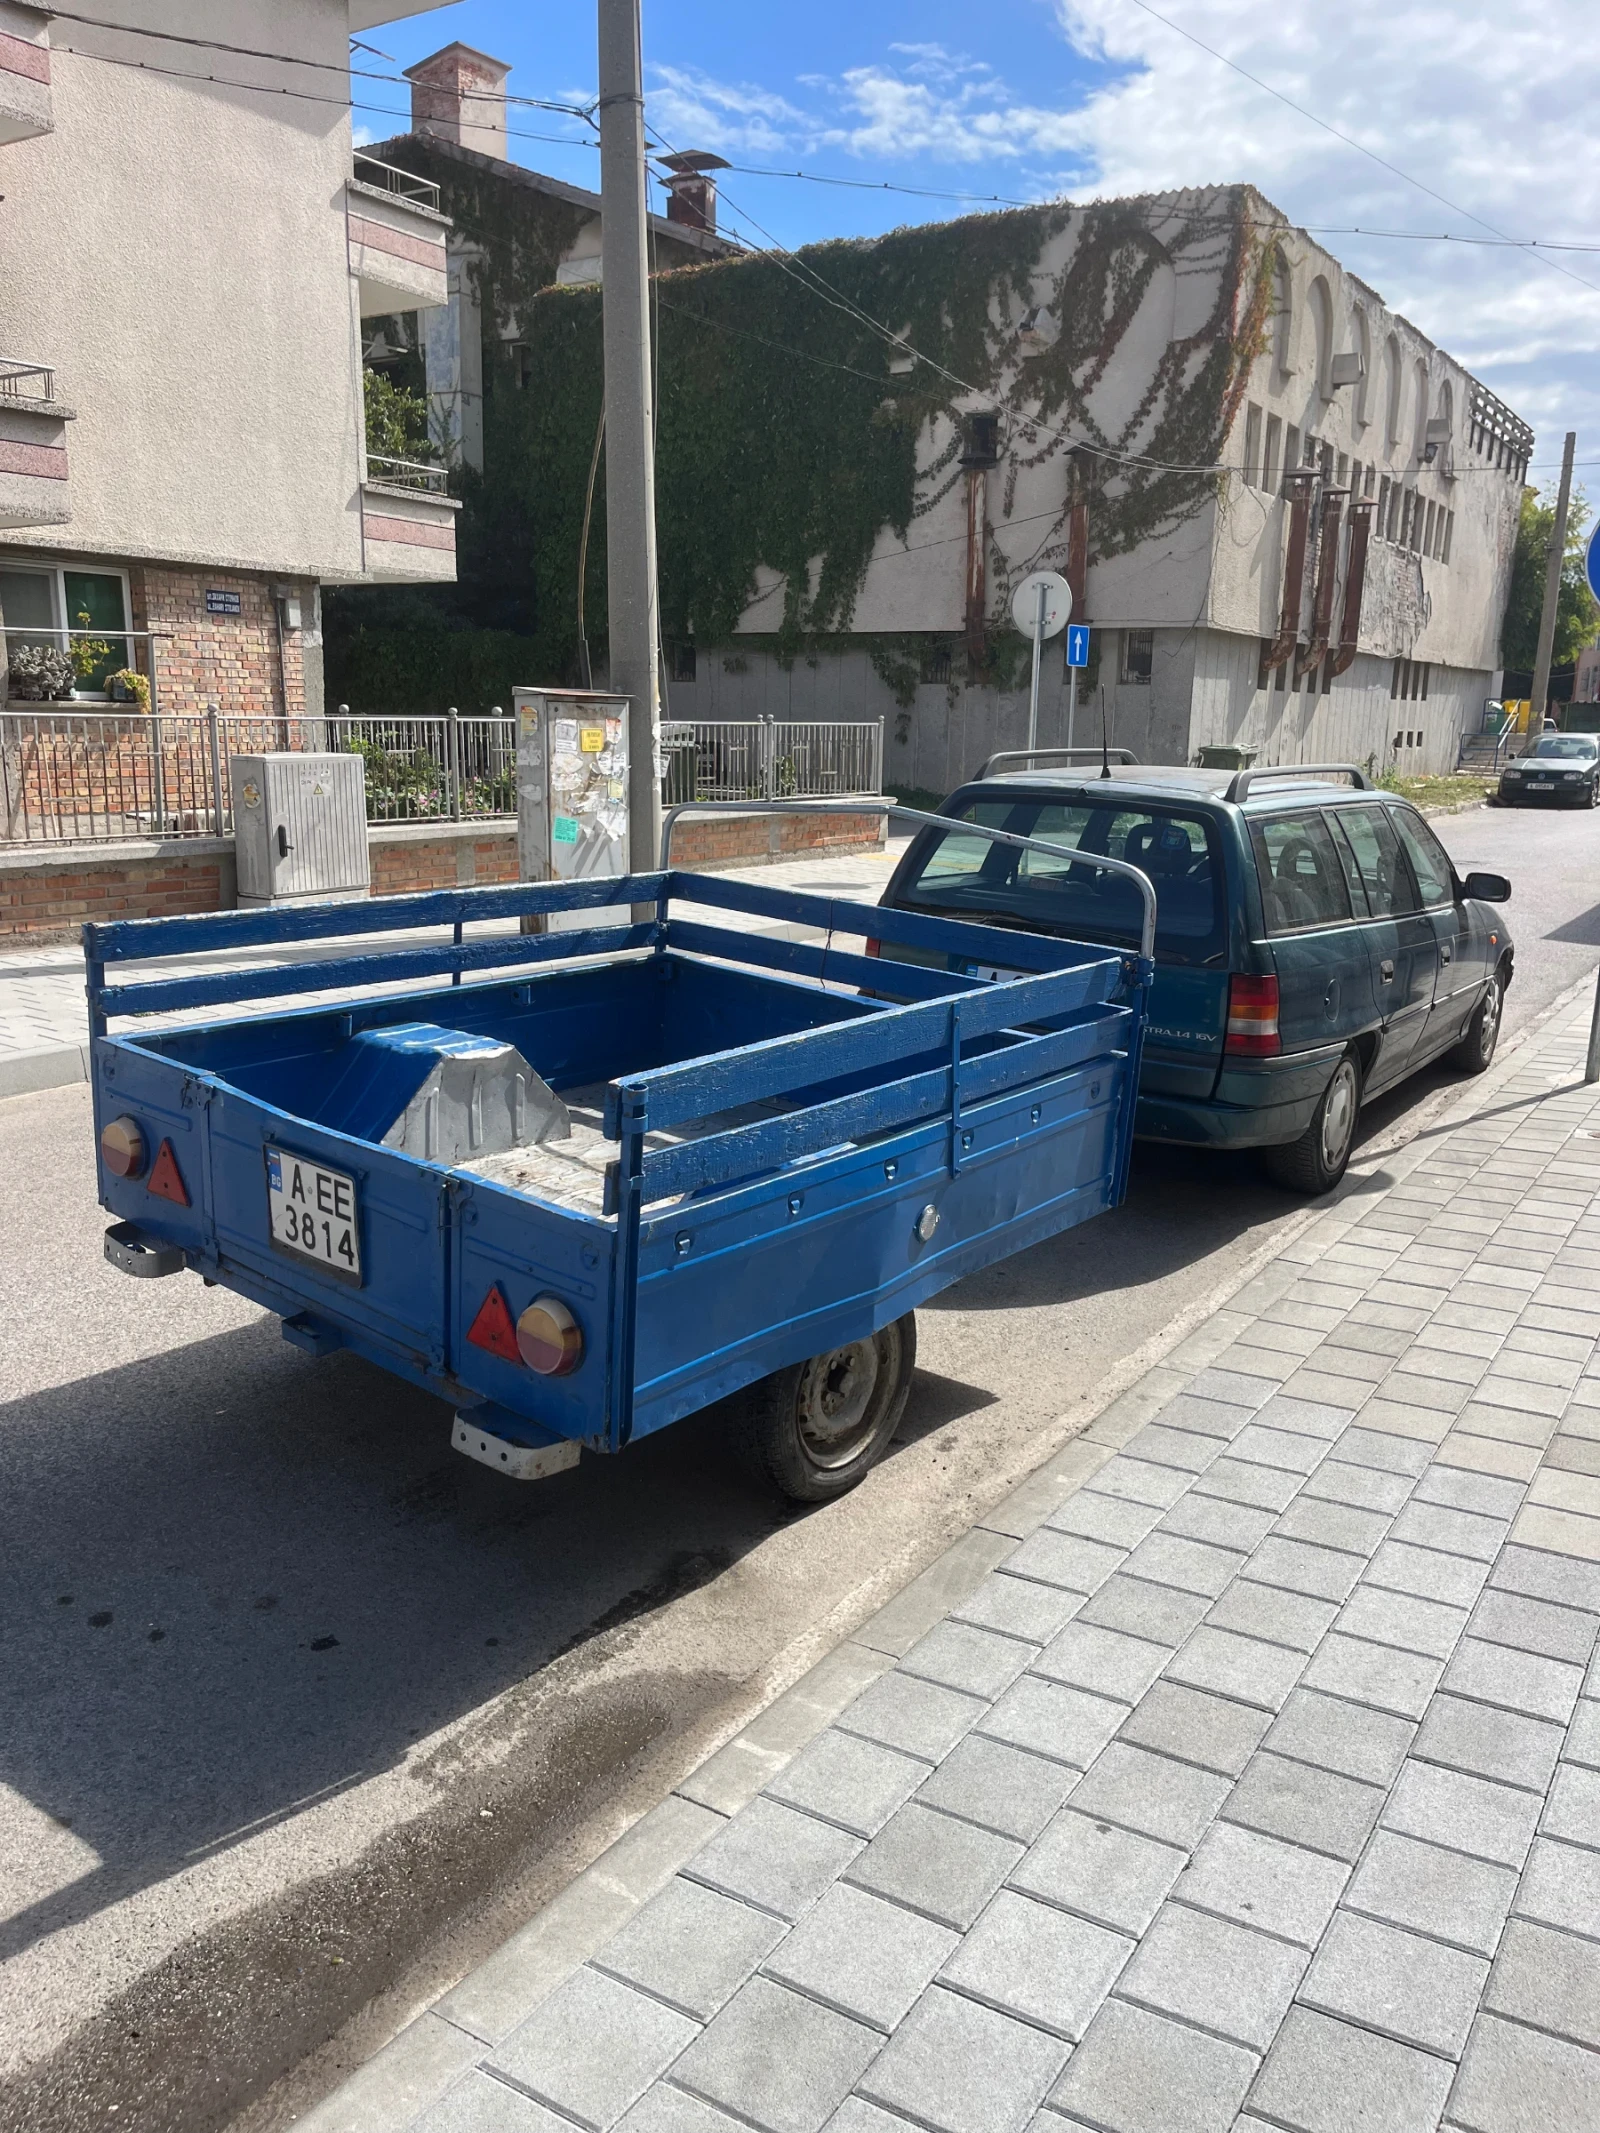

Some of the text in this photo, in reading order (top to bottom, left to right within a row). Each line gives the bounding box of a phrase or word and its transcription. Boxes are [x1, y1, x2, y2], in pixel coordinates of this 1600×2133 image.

[1143, 1025, 1171, 1036] STRA
[271, 1173, 282, 1188] BG
[291, 1163, 352, 1223] A EE
[285, 1204, 355, 1267] 3814
